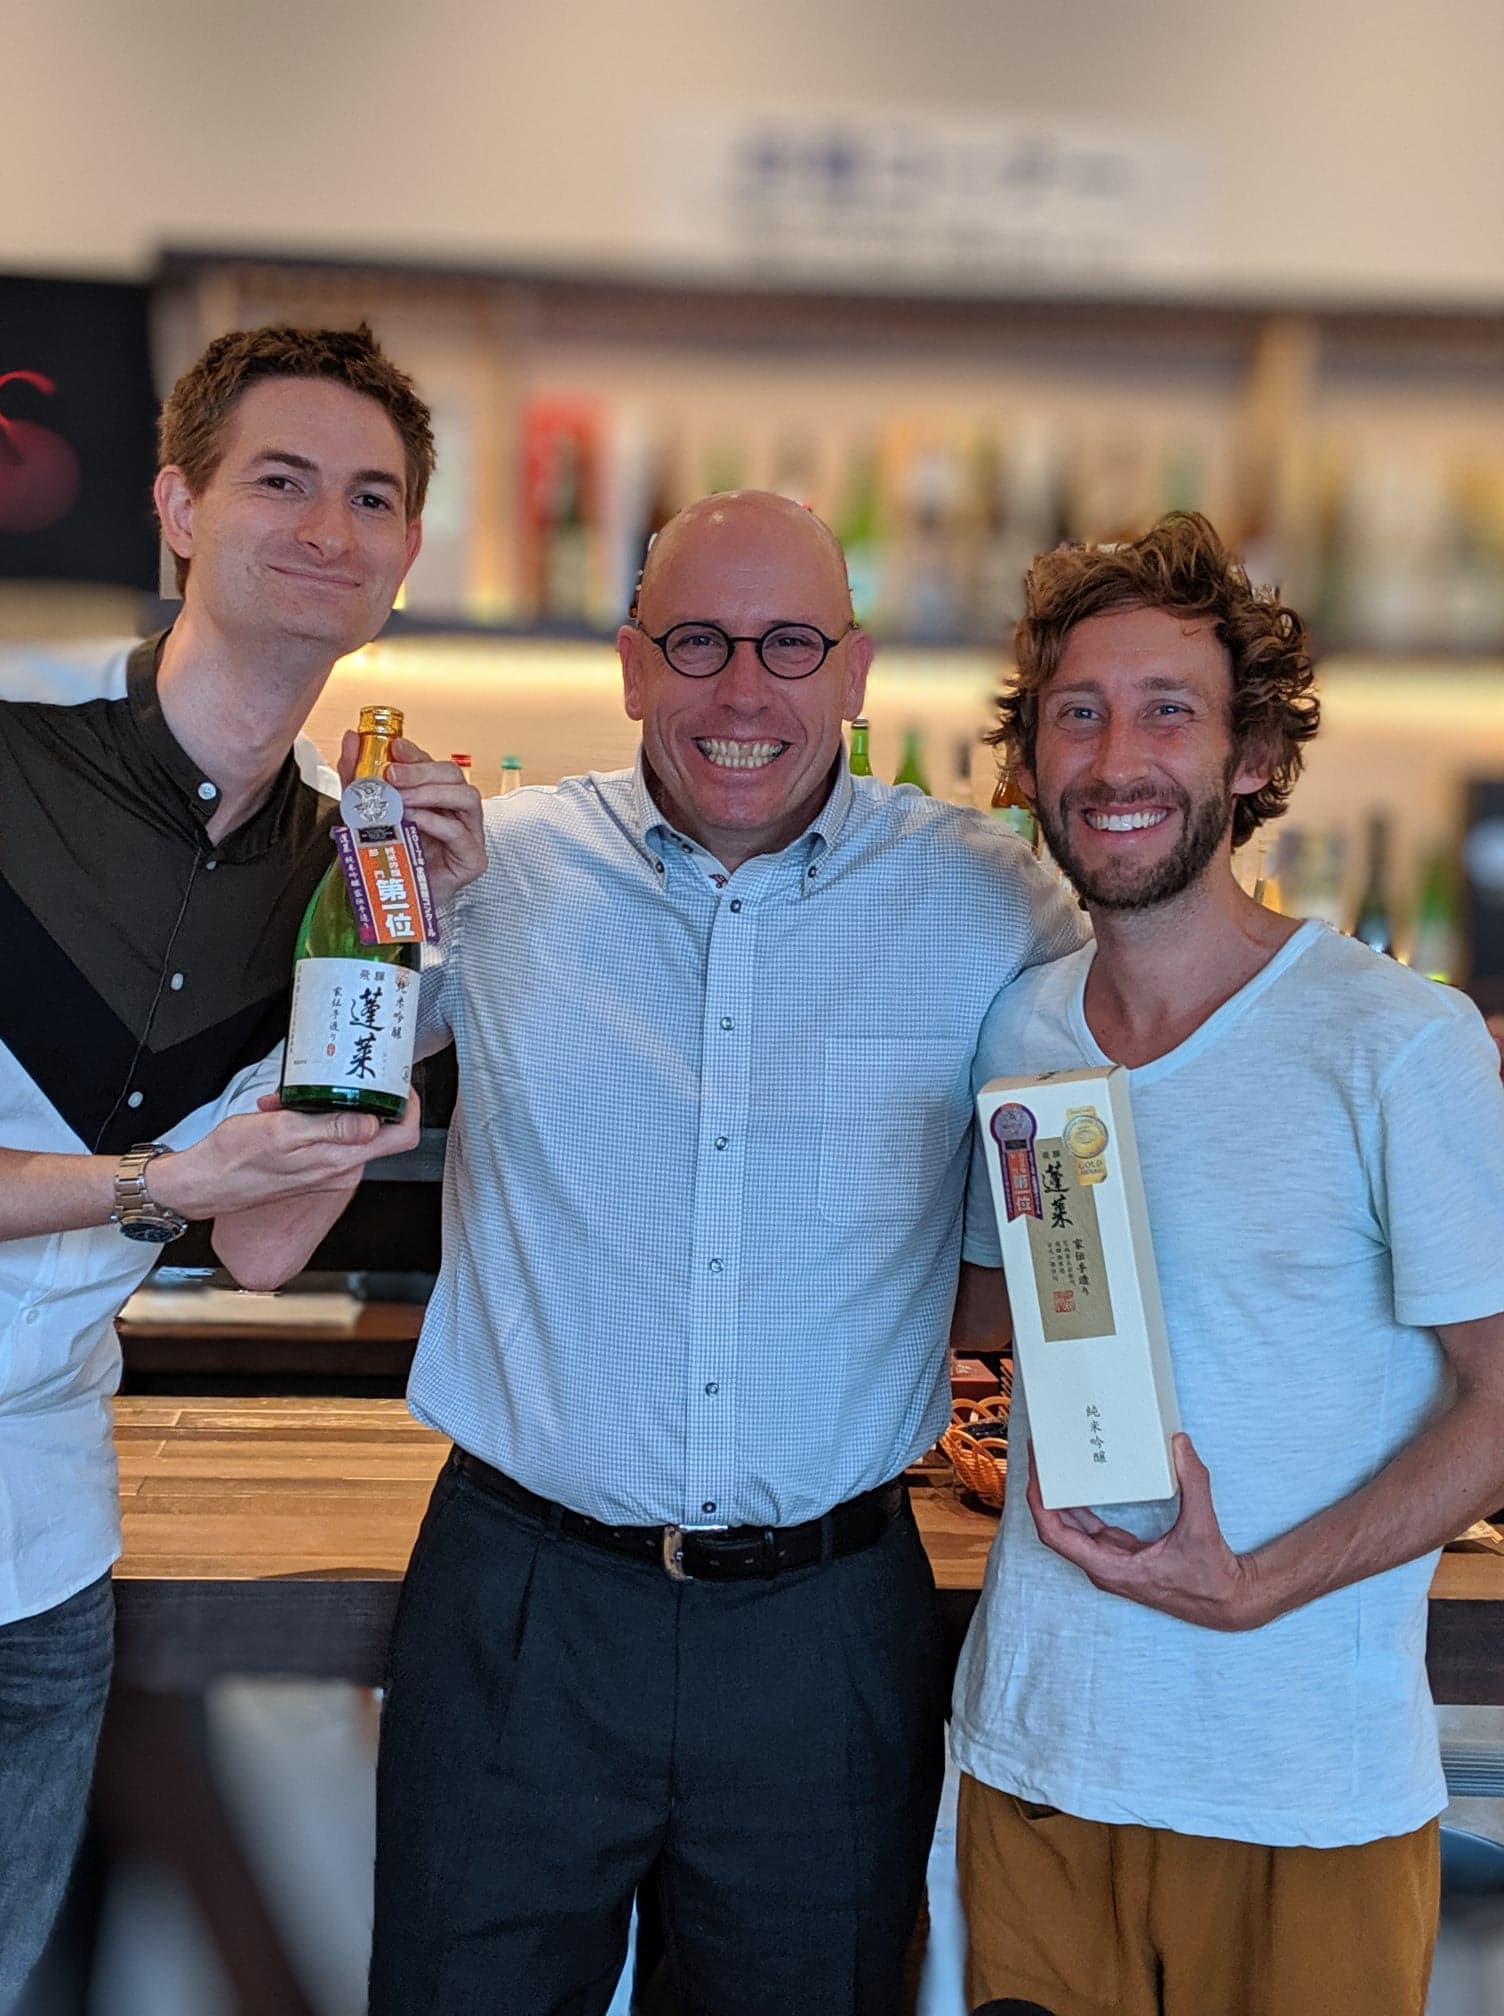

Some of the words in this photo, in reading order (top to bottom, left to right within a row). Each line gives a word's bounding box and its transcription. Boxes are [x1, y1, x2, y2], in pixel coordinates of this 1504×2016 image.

[375, 877, 416, 939] 第一位
[345, 986, 385, 1080] 蓬莱
[1041, 1160, 1074, 1229] 蓬莱
